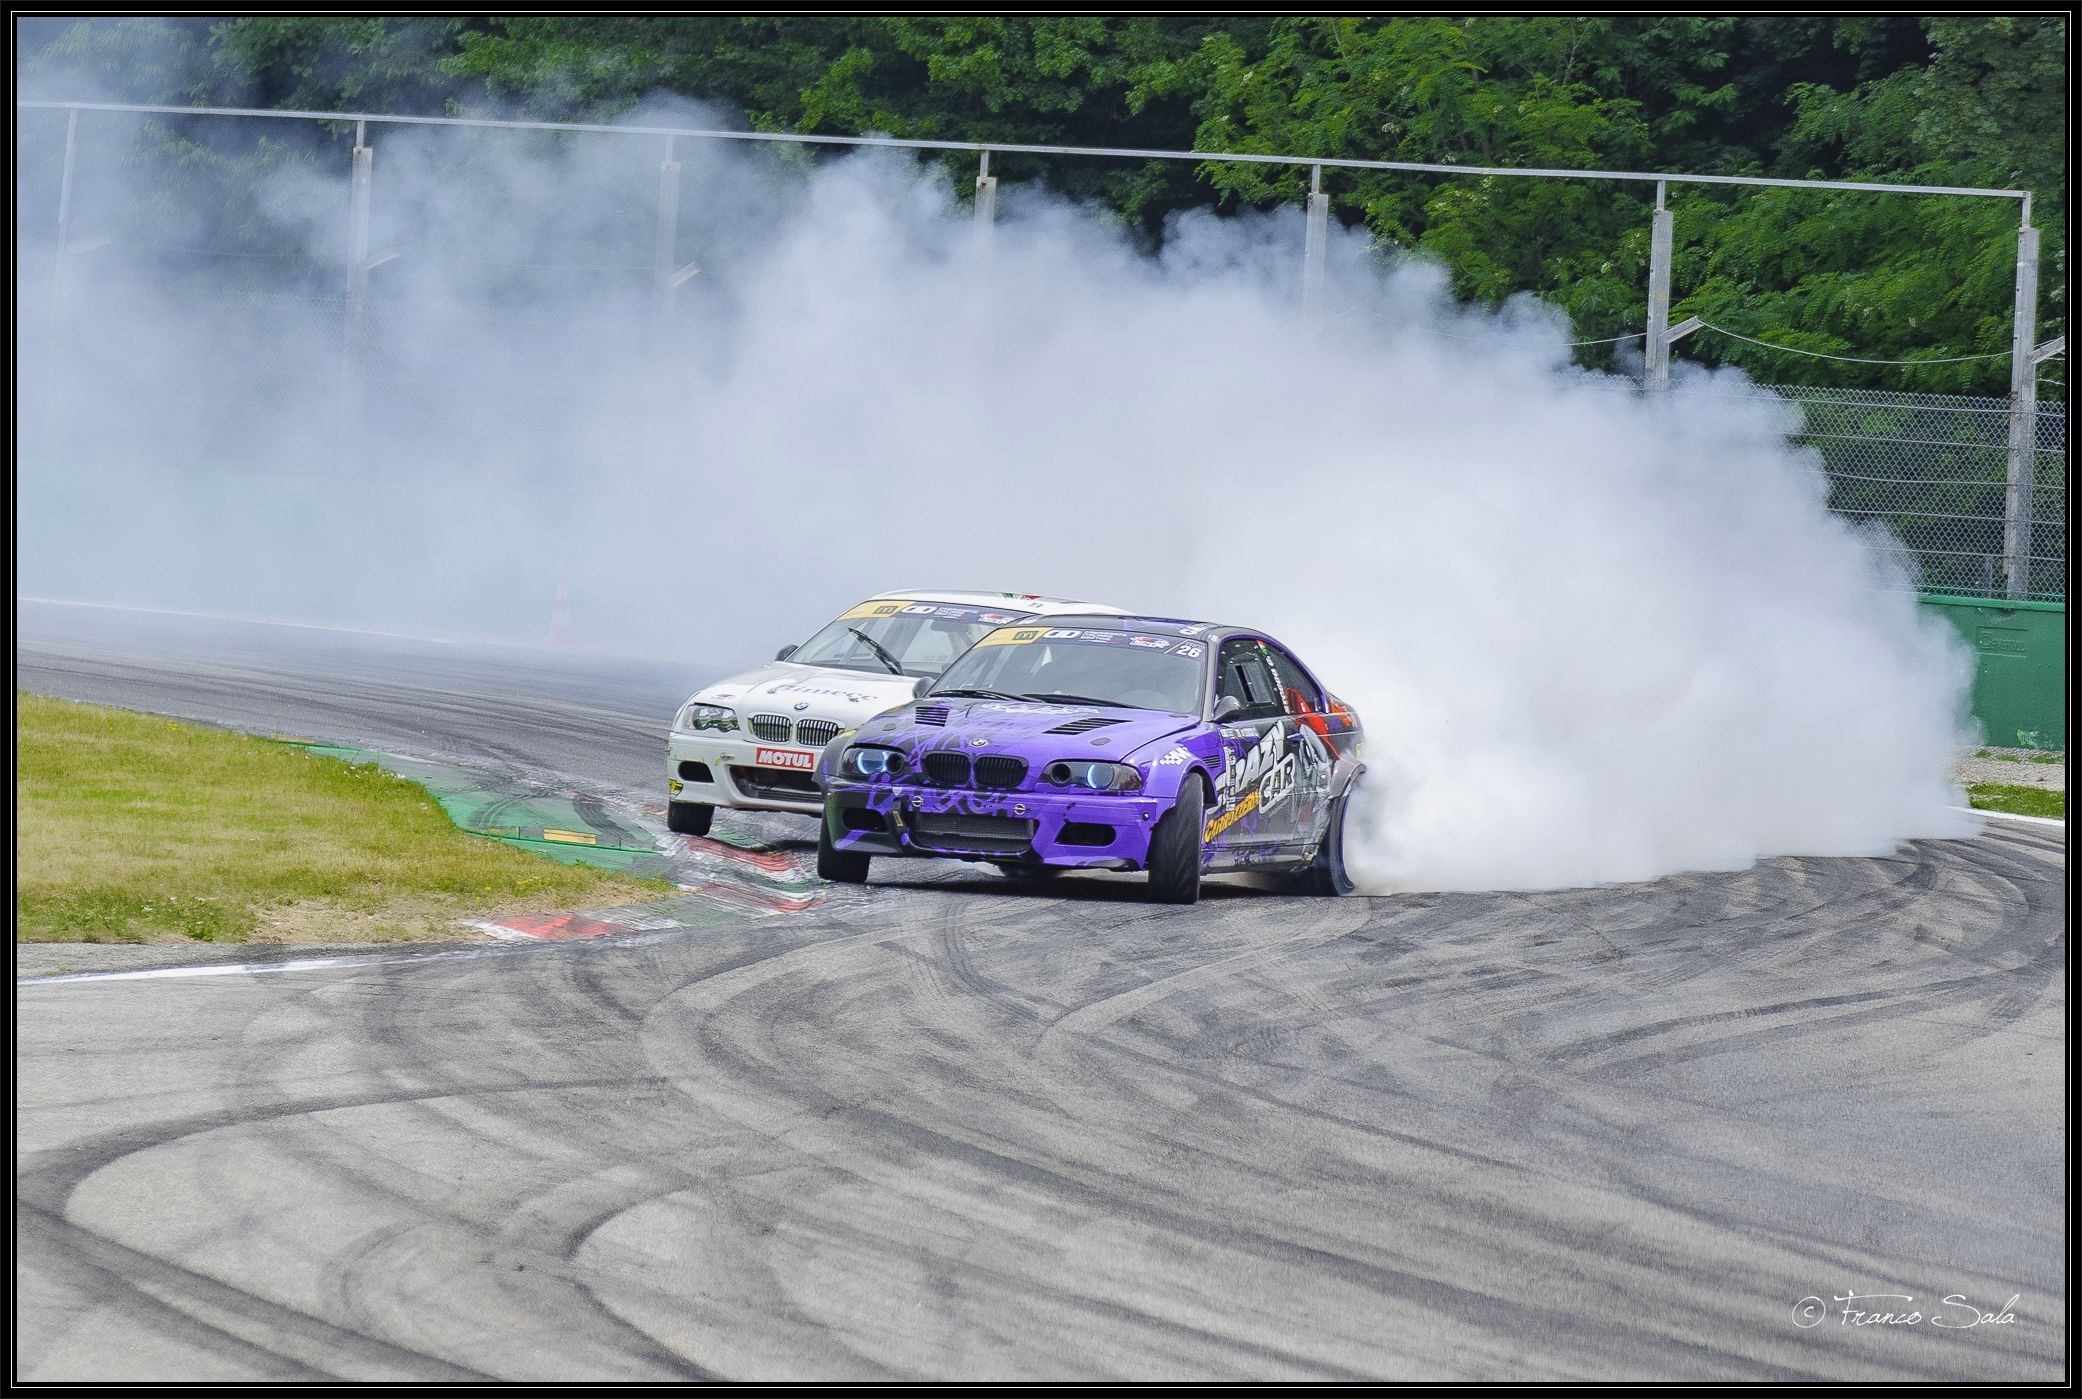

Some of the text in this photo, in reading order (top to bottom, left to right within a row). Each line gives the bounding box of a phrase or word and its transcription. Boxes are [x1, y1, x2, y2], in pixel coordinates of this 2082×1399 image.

[1175, 645, 1203, 658] 26
[758, 750, 813, 770] MOTUL
[1258, 752, 1296, 815] CAR
